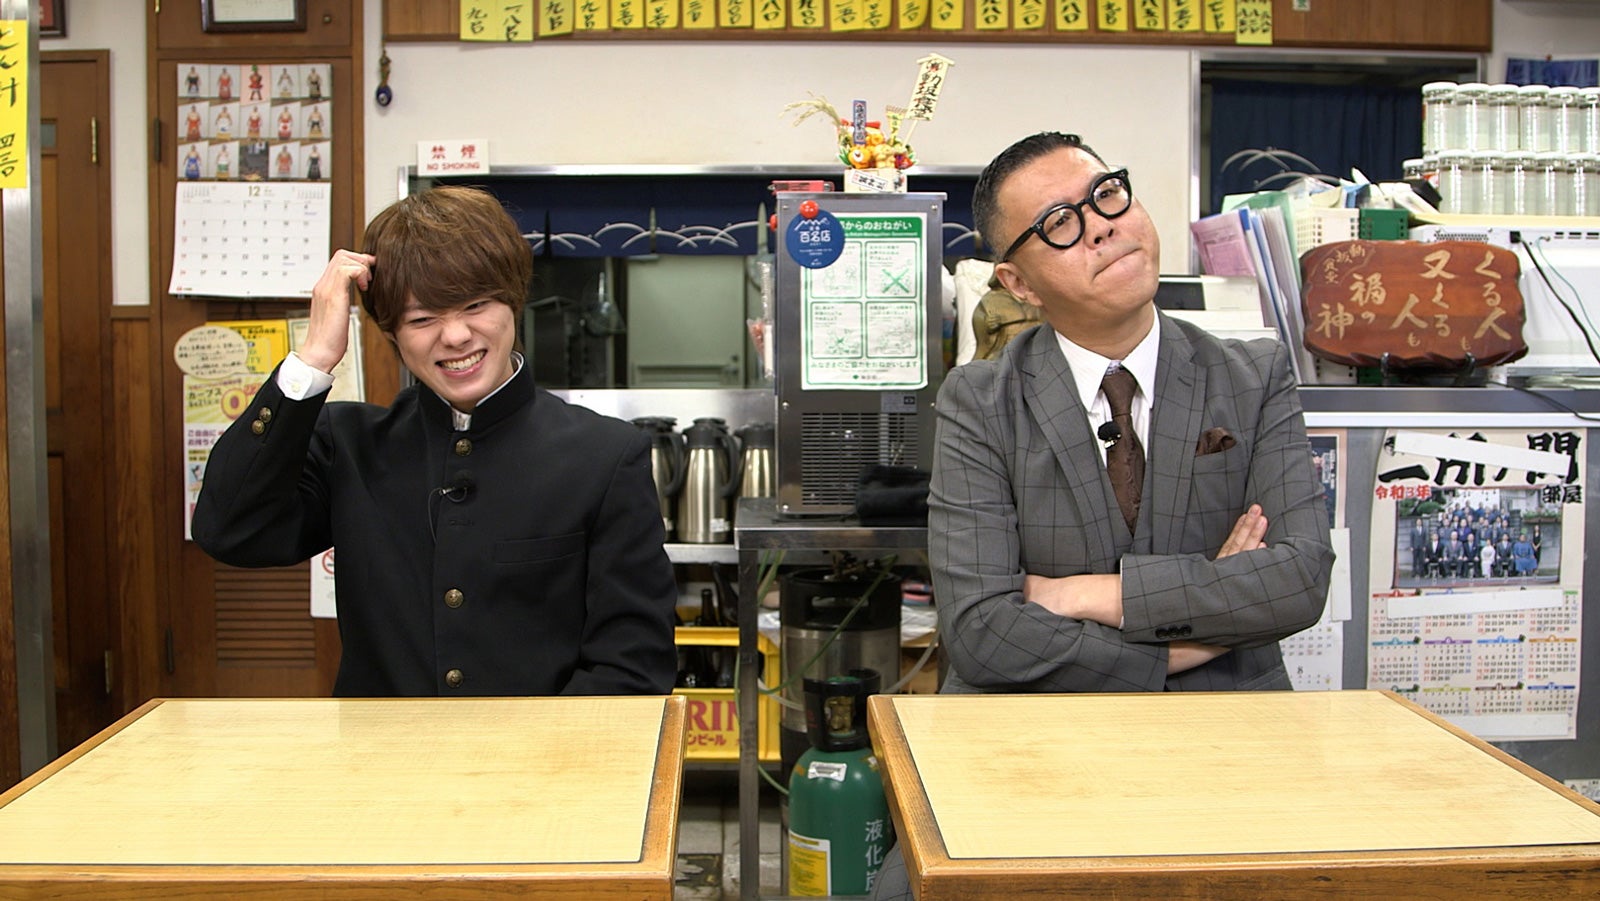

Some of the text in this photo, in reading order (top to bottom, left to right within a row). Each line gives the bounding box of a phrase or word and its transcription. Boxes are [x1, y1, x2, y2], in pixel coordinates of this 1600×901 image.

[432, 145, 475, 158] 禁煙
[248, 185, 260, 197] 12
[800, 230, 831, 243] 百名店
[1375, 485, 1432, 500] 令和3年
[1542, 484, 1582, 504] 部屋
